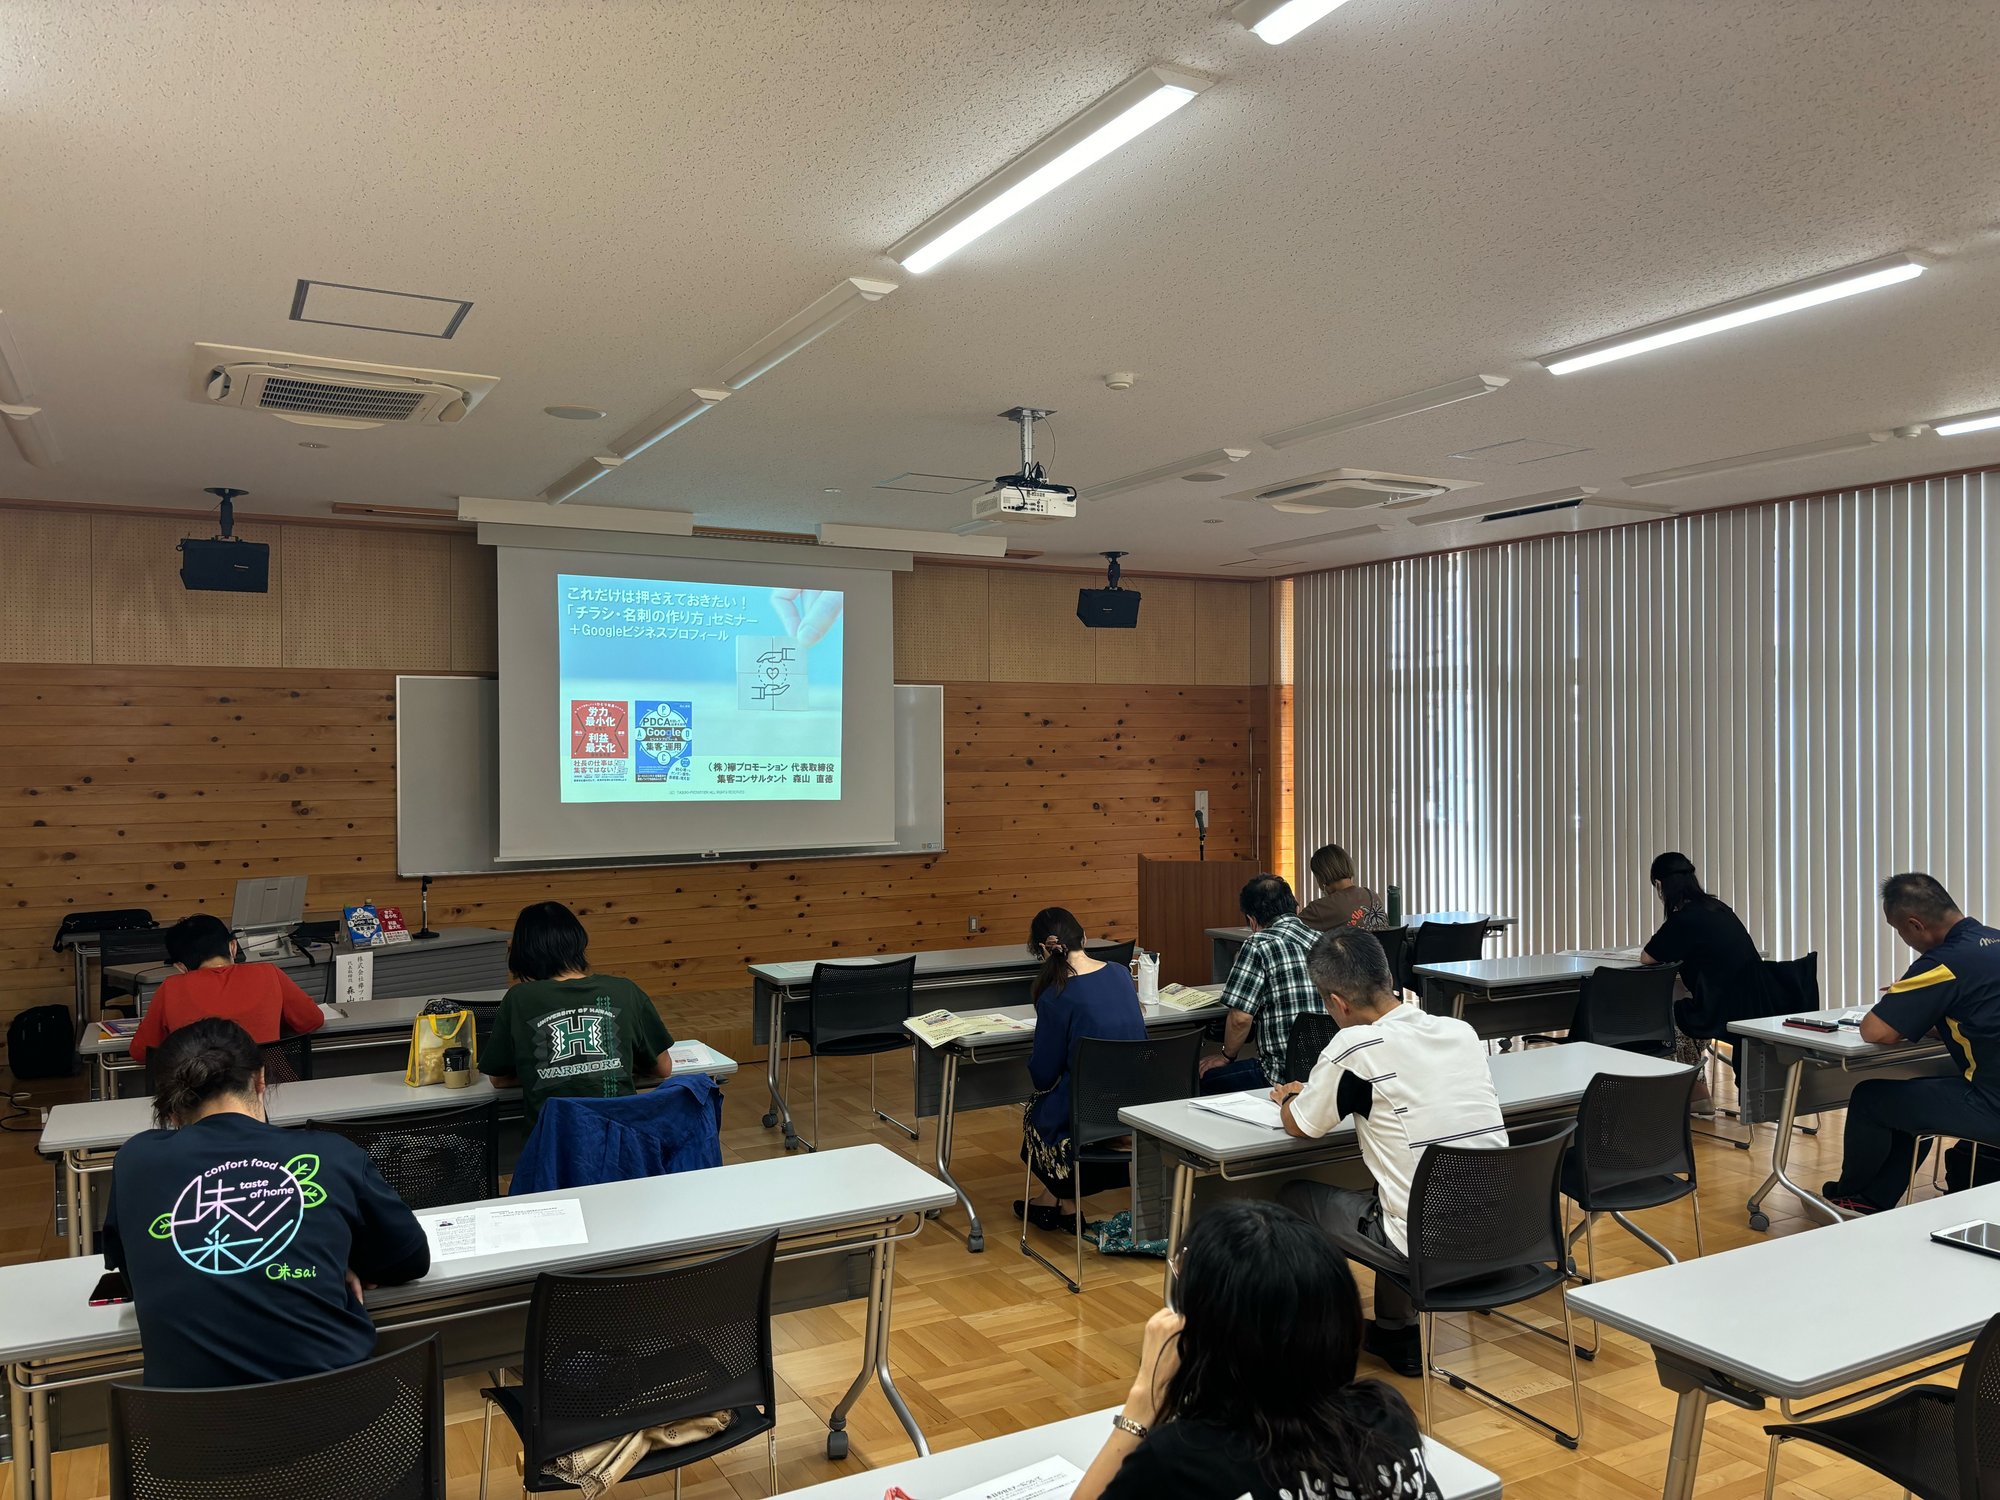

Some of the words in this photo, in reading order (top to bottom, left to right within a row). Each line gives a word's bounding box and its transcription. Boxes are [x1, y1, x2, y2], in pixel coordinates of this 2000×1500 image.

[567, 587, 748, 610] これだけは押さえておきたい！
[567, 604, 758, 627] 「チラシ・名刺の作り方」セミナー
[585, 716, 616, 726] 最小化
[642, 717, 671, 726] PDCA
[646, 728, 681, 738] Google
[585, 743, 616, 753] 最大化
[717, 774, 788, 783] 集客コンサルタント
[537, 1009, 576, 1028] UNIVERSITY
[548, 1015, 608, 1063] H
[537, 1058, 621, 1079] WARRIORS
[204, 1159, 249, 1178] confort
[250, 1158, 279, 1171] food
[239, 1178, 269, 1190] taste
[249, 1189, 263, 1200] of
[263, 1186, 295, 1198] home
